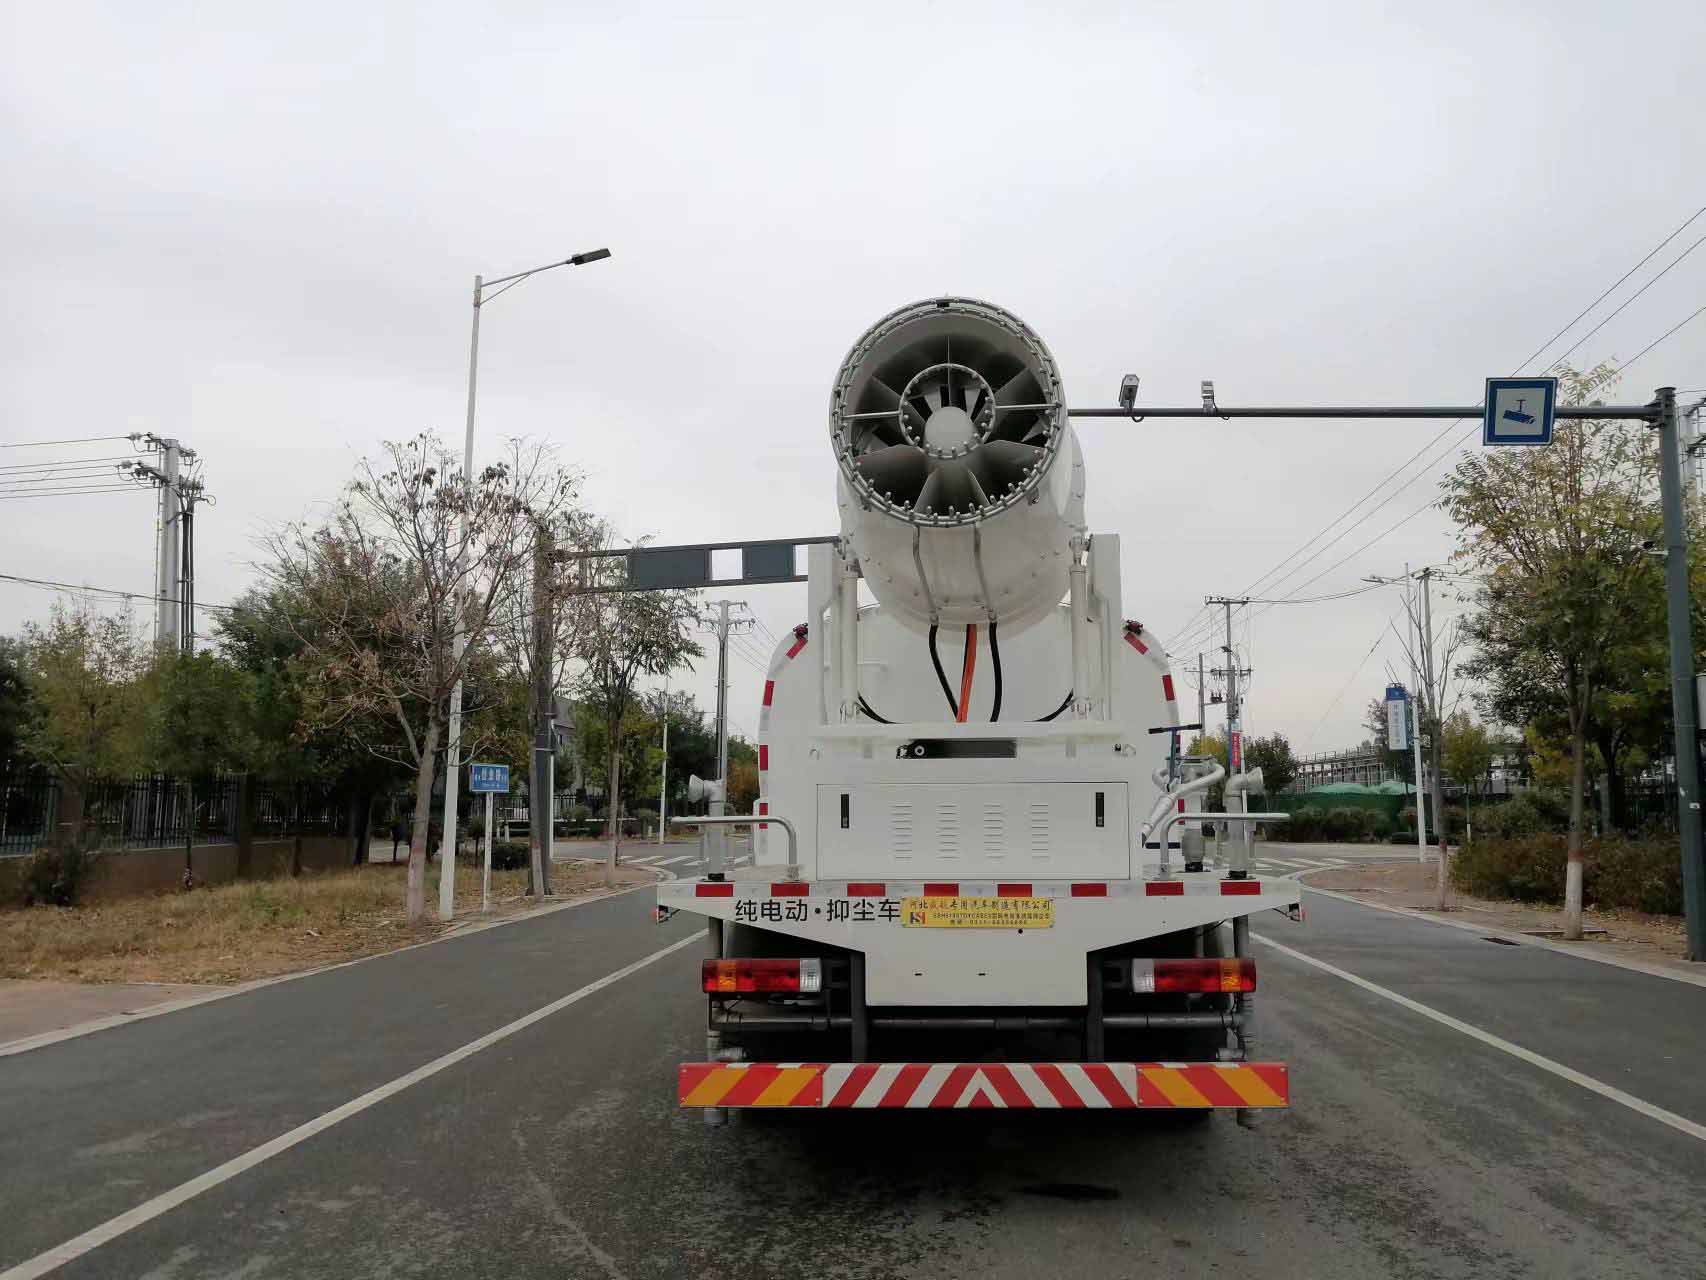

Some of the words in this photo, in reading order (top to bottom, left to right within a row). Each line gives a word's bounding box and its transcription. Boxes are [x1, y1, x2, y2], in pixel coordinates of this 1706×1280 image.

[735, 899, 900, 922] 纯电动·抑尘车
